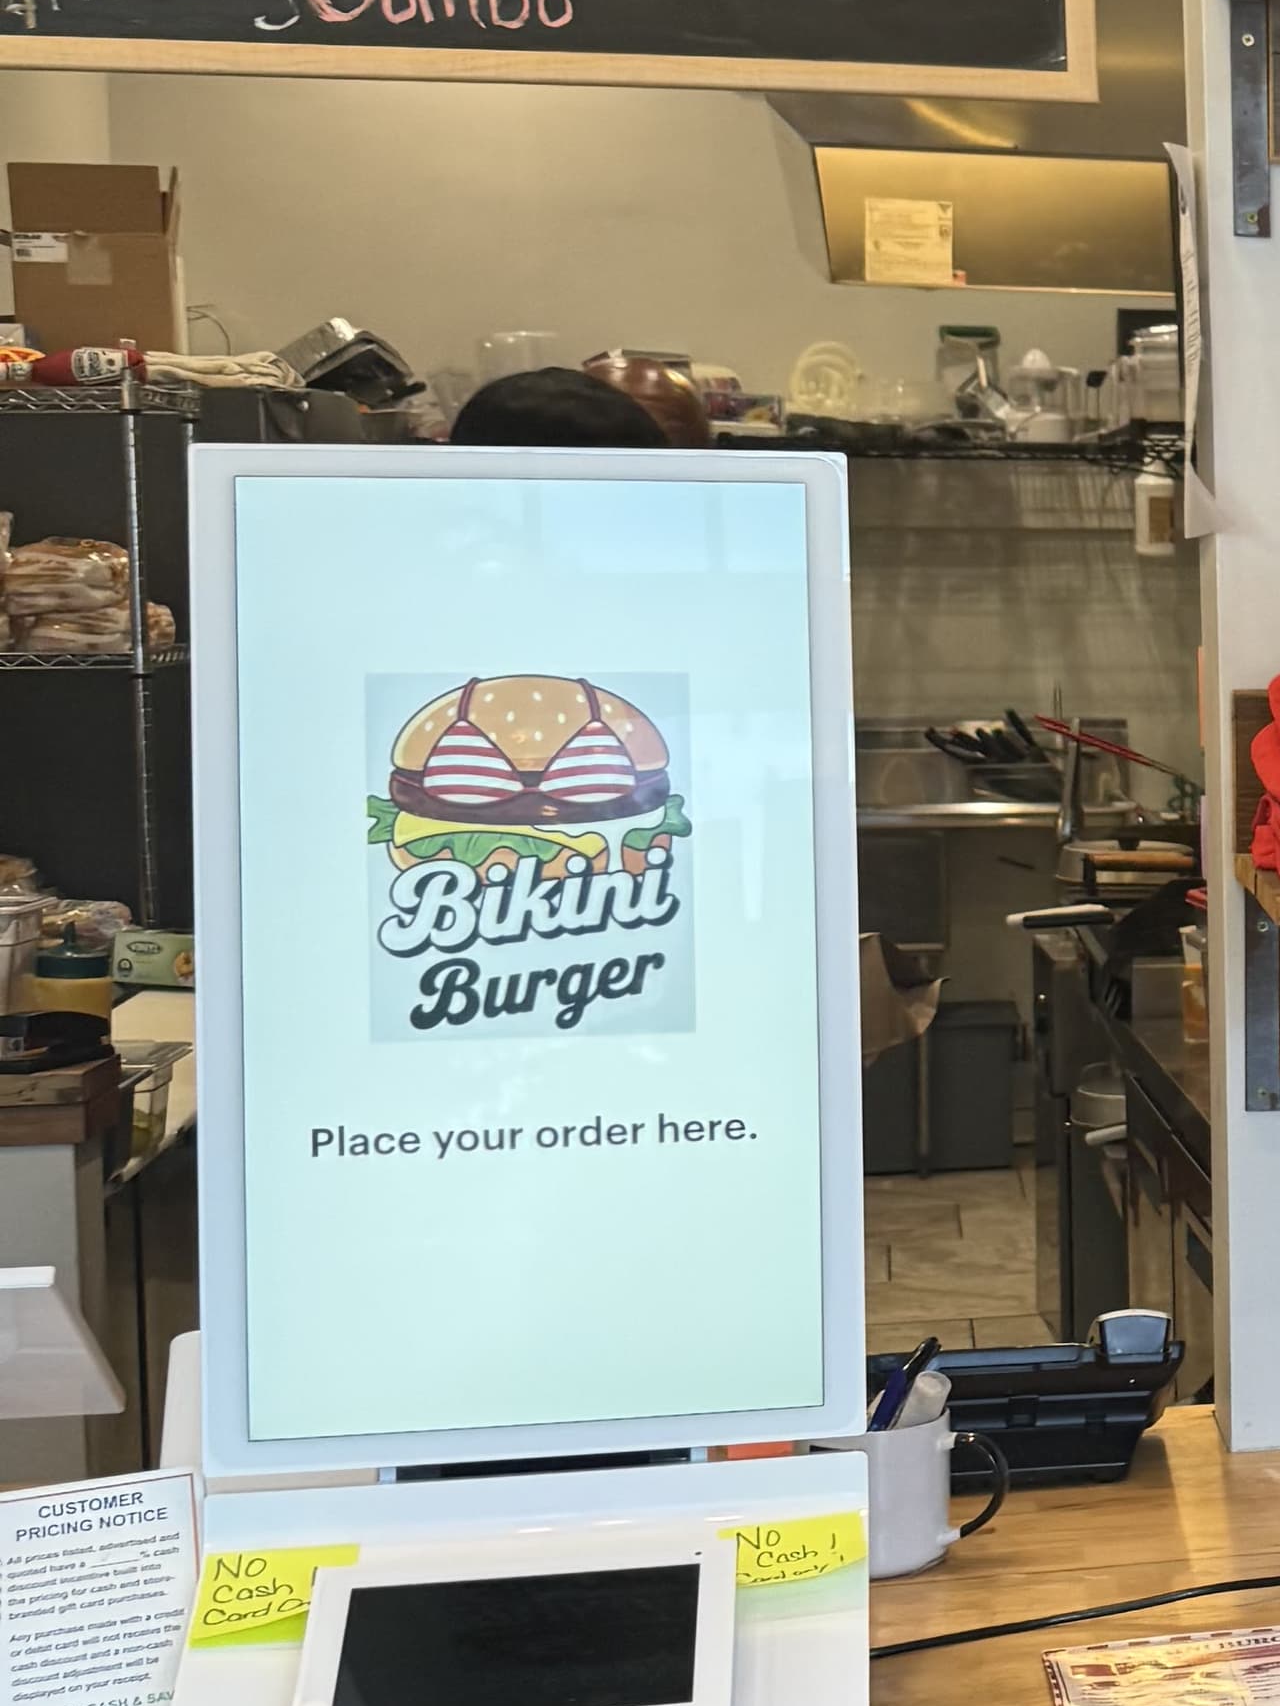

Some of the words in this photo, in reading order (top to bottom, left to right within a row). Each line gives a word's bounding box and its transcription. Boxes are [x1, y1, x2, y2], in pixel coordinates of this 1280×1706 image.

[377, 845, 681, 958] Bikini
[409, 952, 666, 1030] Burger
[311, 1124, 421, 1158] Place
[432, 1122, 523, 1159] your
[535, 1115, 645, 1149] order
[657, 1112, 758, 1144] here.
[38, 1492, 144, 1519] CUSTOMER
[16, 1519, 93, 1542] PRICING
[99, 1507, 169, 1529] NOTICE
[153, 1547, 180, 1557] cash
[214, 1554, 267, 1581] NO
[29, 1591, 69, 1605] pricing
[90, 1583, 117, 1594] cash
[119, 1579, 140, 1589] and
[212, 1577, 294, 1604] Cash
[203, 1601, 273, 1625] Card
[133, 1696, 142, 1706] &
[147, 1690, 175, 1704] SAV
